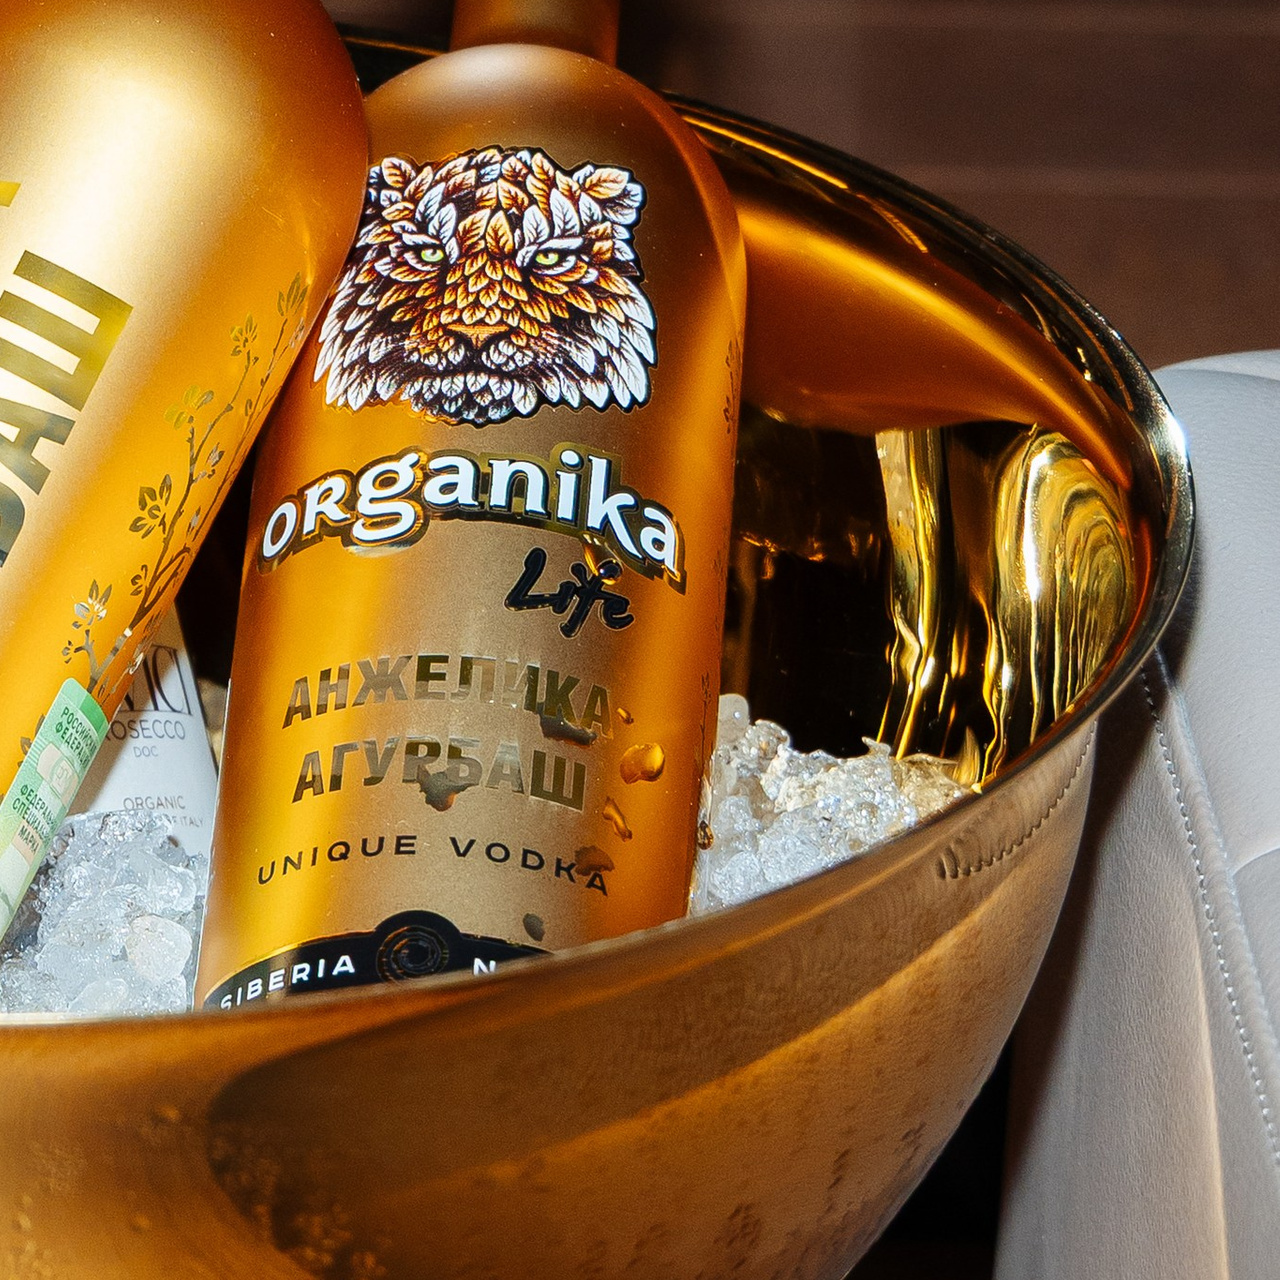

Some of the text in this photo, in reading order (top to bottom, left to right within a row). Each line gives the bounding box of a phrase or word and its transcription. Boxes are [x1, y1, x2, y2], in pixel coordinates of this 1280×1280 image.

[504, 547, 635, 637] Life
[281, 653, 614, 742] АНЖЕЛИКА
[105, 719, 186, 741] OSECCO
[133, 745, 159, 759] DOC
[123, 795, 186, 811] ORGANIC
[291, 736, 588, 812] АГУРБАШ
[257, 834, 609, 897] UNIQUE VODKA
[220, 954, 356, 1011] SIBERIA
